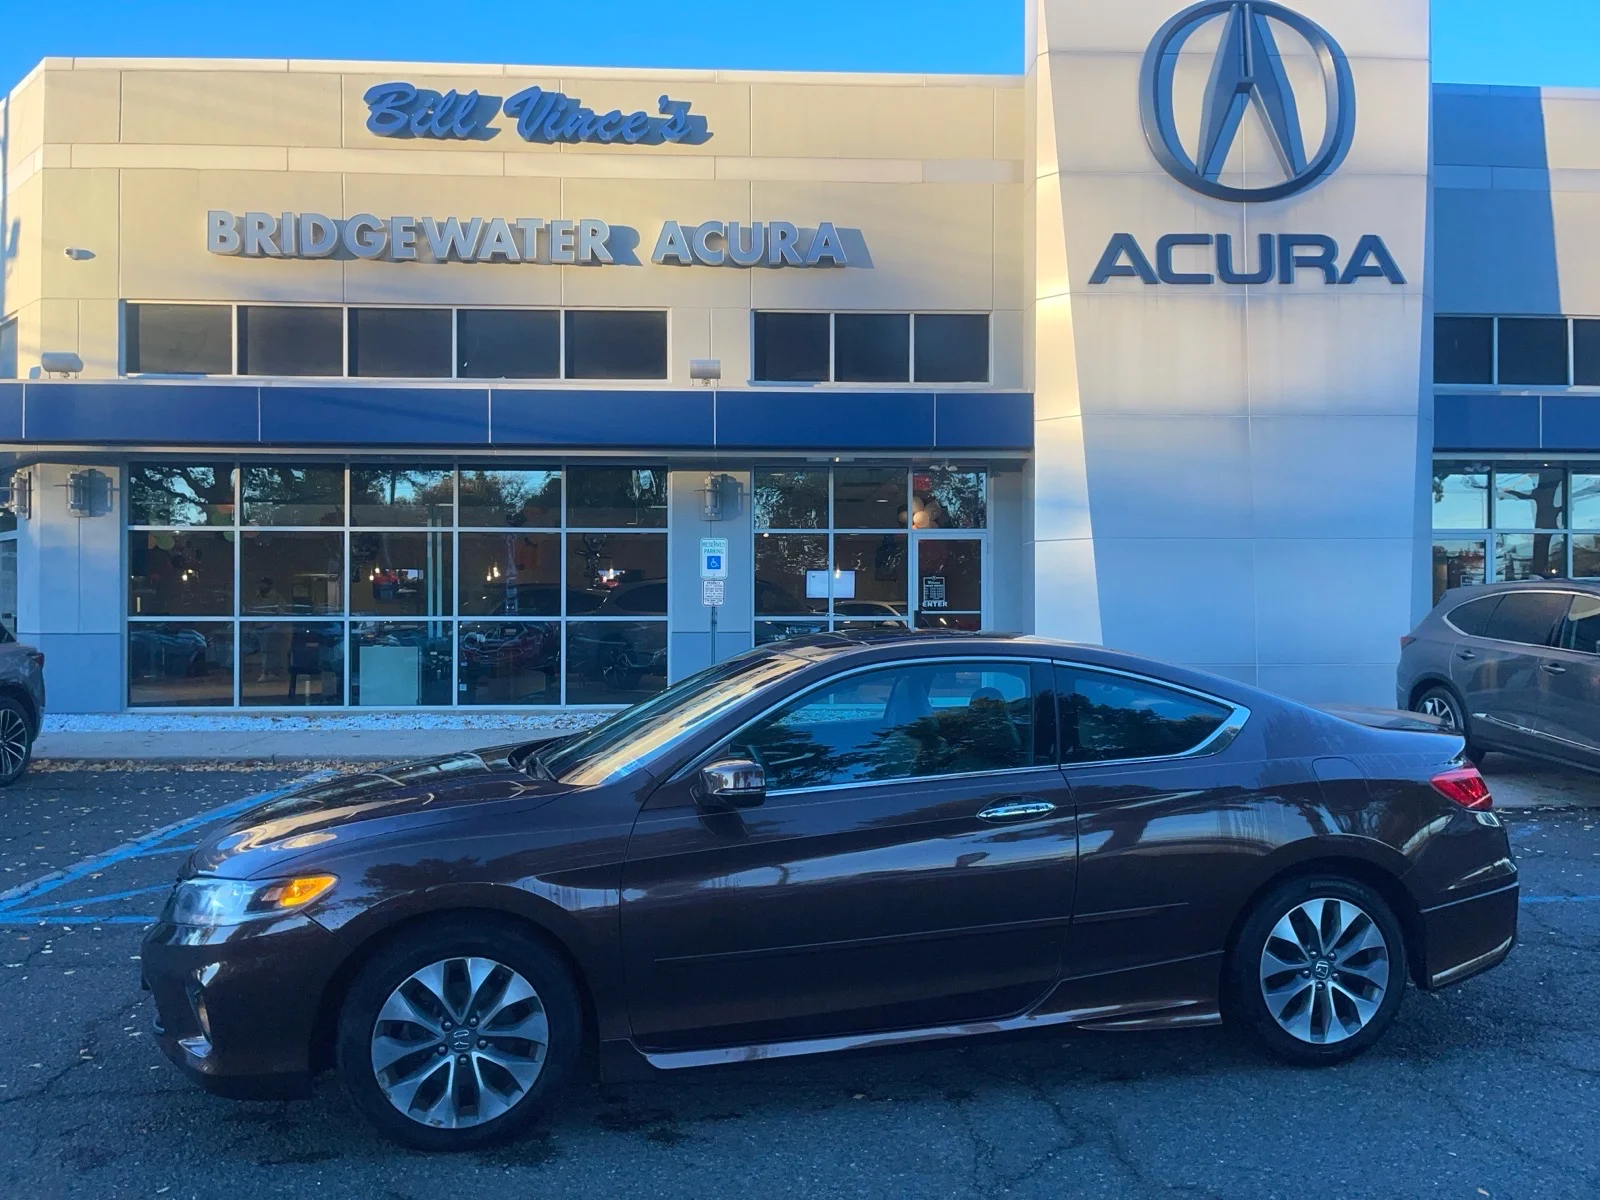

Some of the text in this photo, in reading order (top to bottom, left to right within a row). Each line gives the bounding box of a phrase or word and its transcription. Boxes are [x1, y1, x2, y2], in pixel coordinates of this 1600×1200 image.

[363, 82, 692, 144] Bill Vince's
[207, 210, 849, 266] BRIDGEWATER ACURA
[1088, 233, 1407, 284] ACURA
